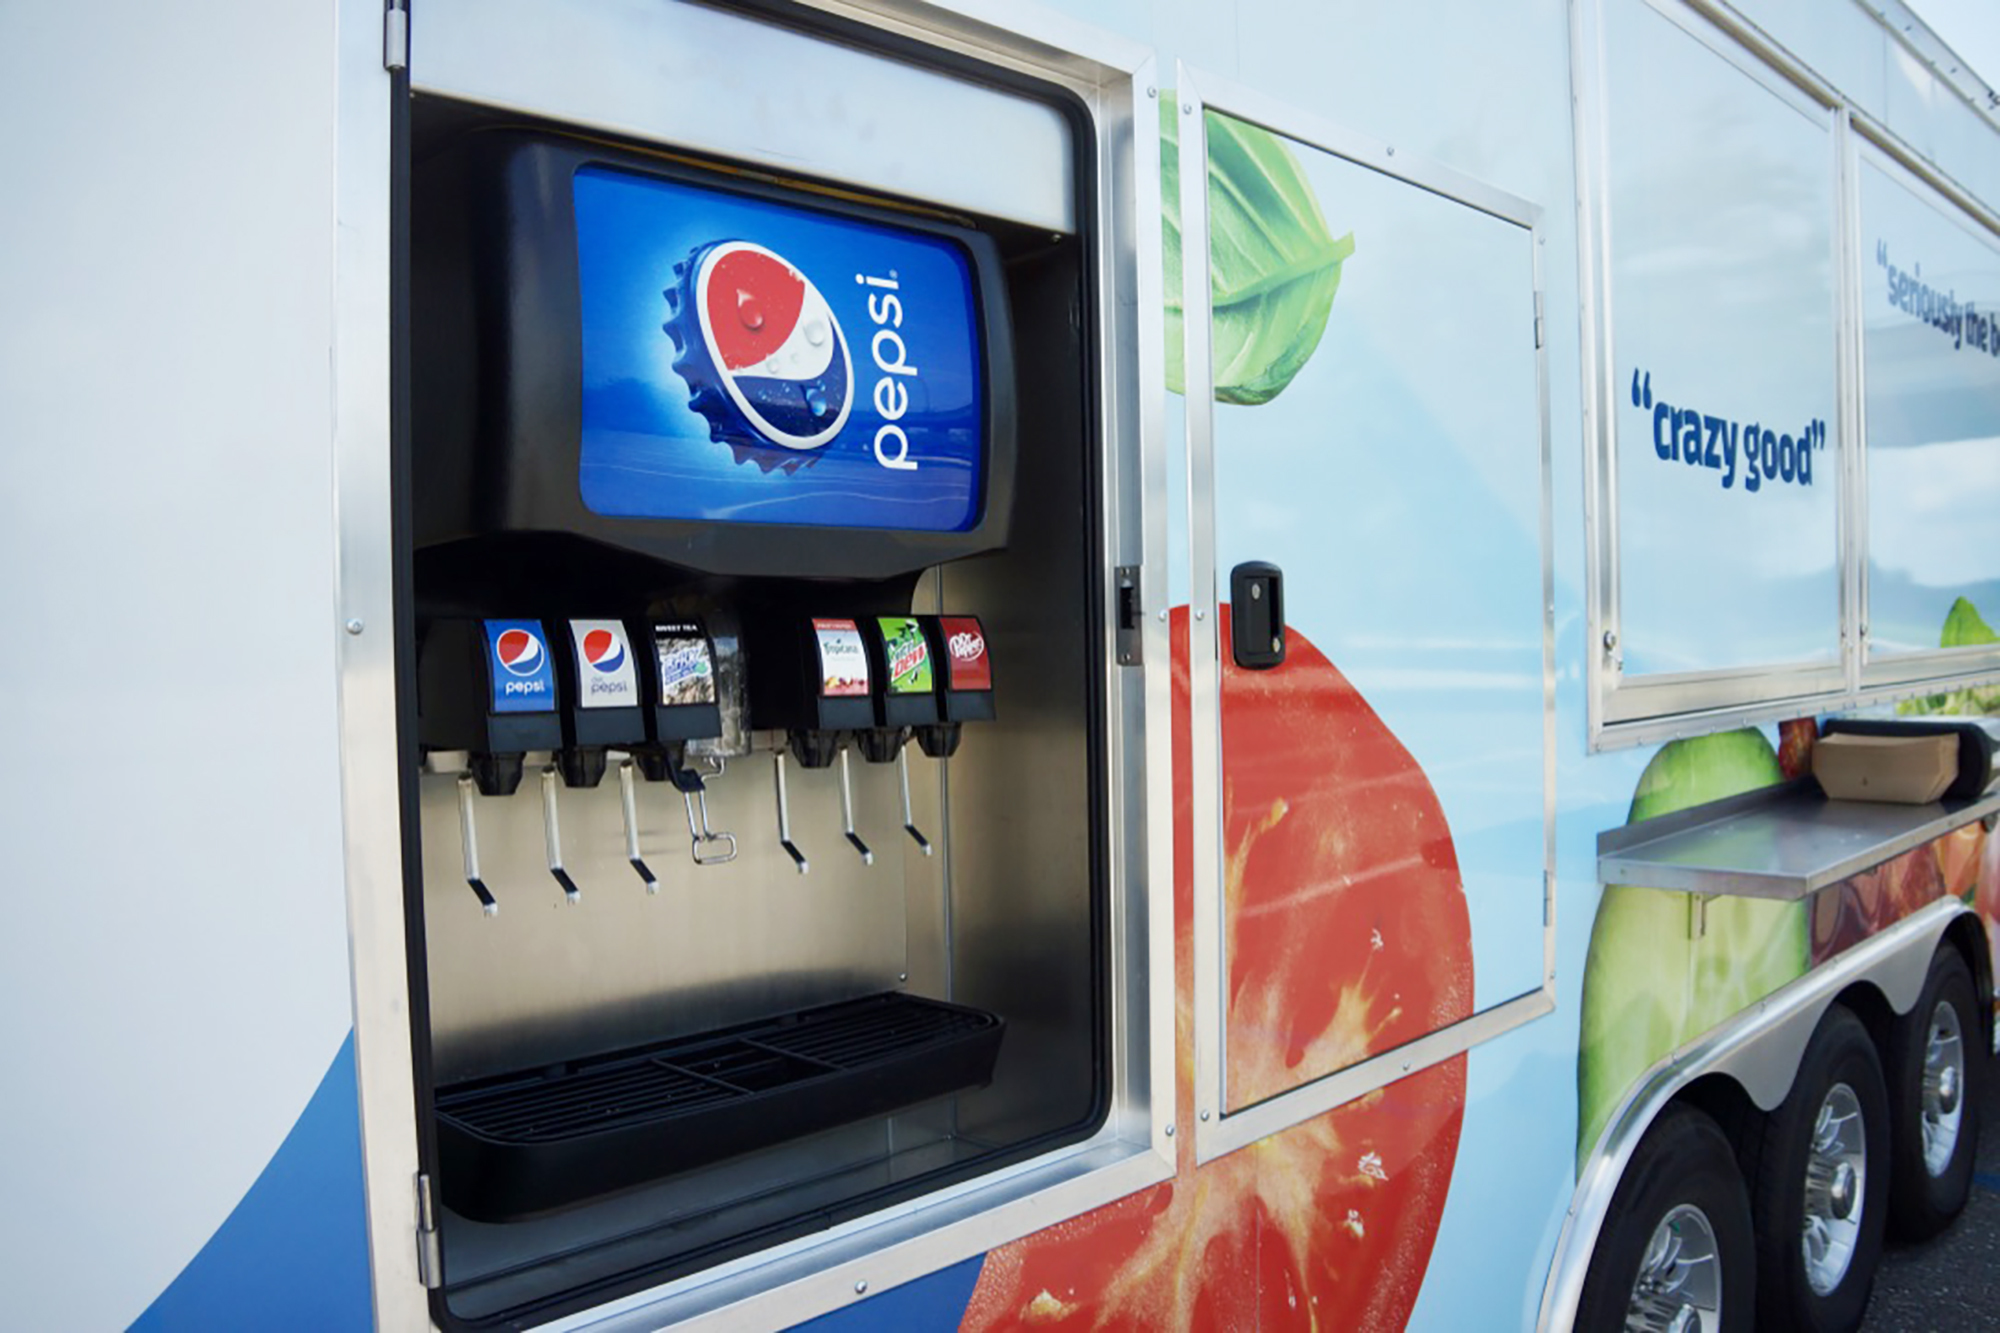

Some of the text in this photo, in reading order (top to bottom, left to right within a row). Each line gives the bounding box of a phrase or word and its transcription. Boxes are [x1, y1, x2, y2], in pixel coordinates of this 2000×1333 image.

[855, 273, 918, 470] pepsi
[505, 679, 545, 695] pepsi
[591, 680, 627, 694] pepsi
